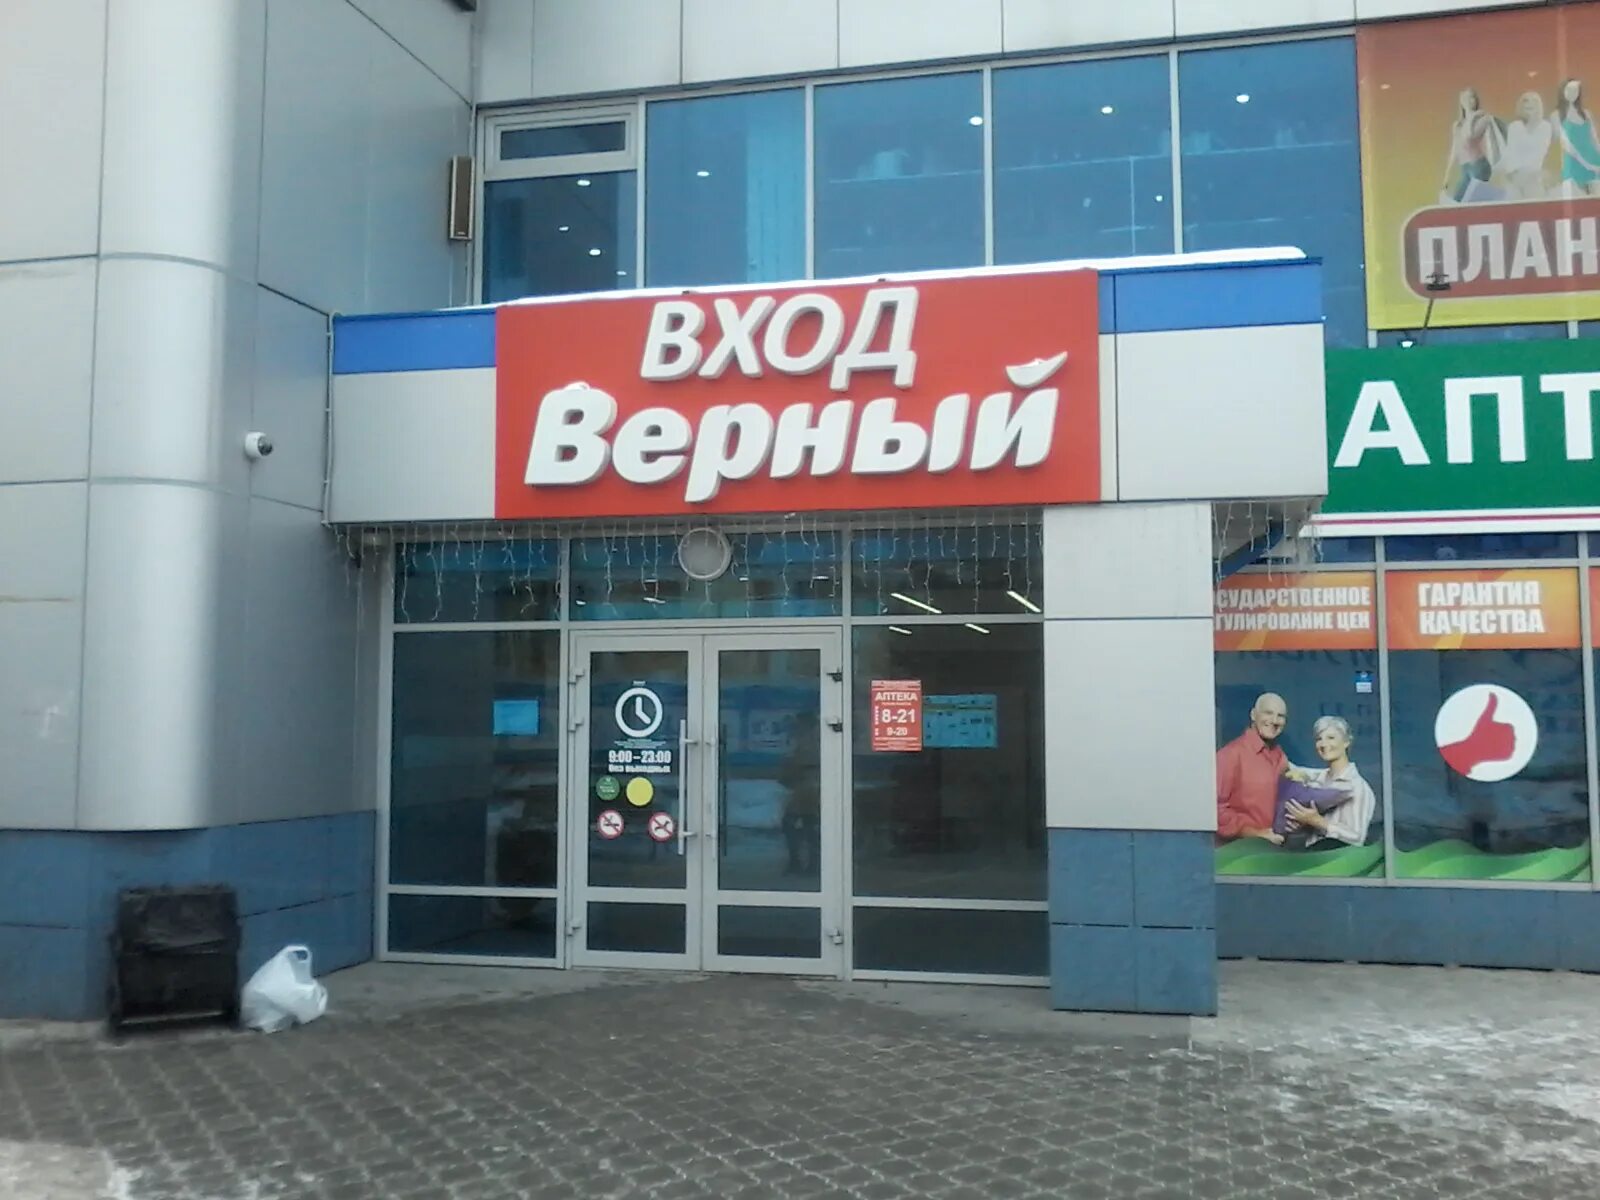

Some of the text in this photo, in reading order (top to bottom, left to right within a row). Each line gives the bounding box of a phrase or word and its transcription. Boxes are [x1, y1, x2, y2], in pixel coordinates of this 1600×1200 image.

[1417, 217, 1599, 285] ПЛАН
[640, 287, 919, 391] ВХОД
[524, 352, 1067, 503] Верный
[1334, 371, 1600, 467] АПТ
[1418, 581, 1540, 606] ГАРАНТИЯ
[1337, 611, 1370, 632] ЦЕН
[1419, 609, 1545, 634] КАЧЕСТВА
[875, 691, 918, 701] АПТЕКА
[882, 709, 915, 723] 8-21
